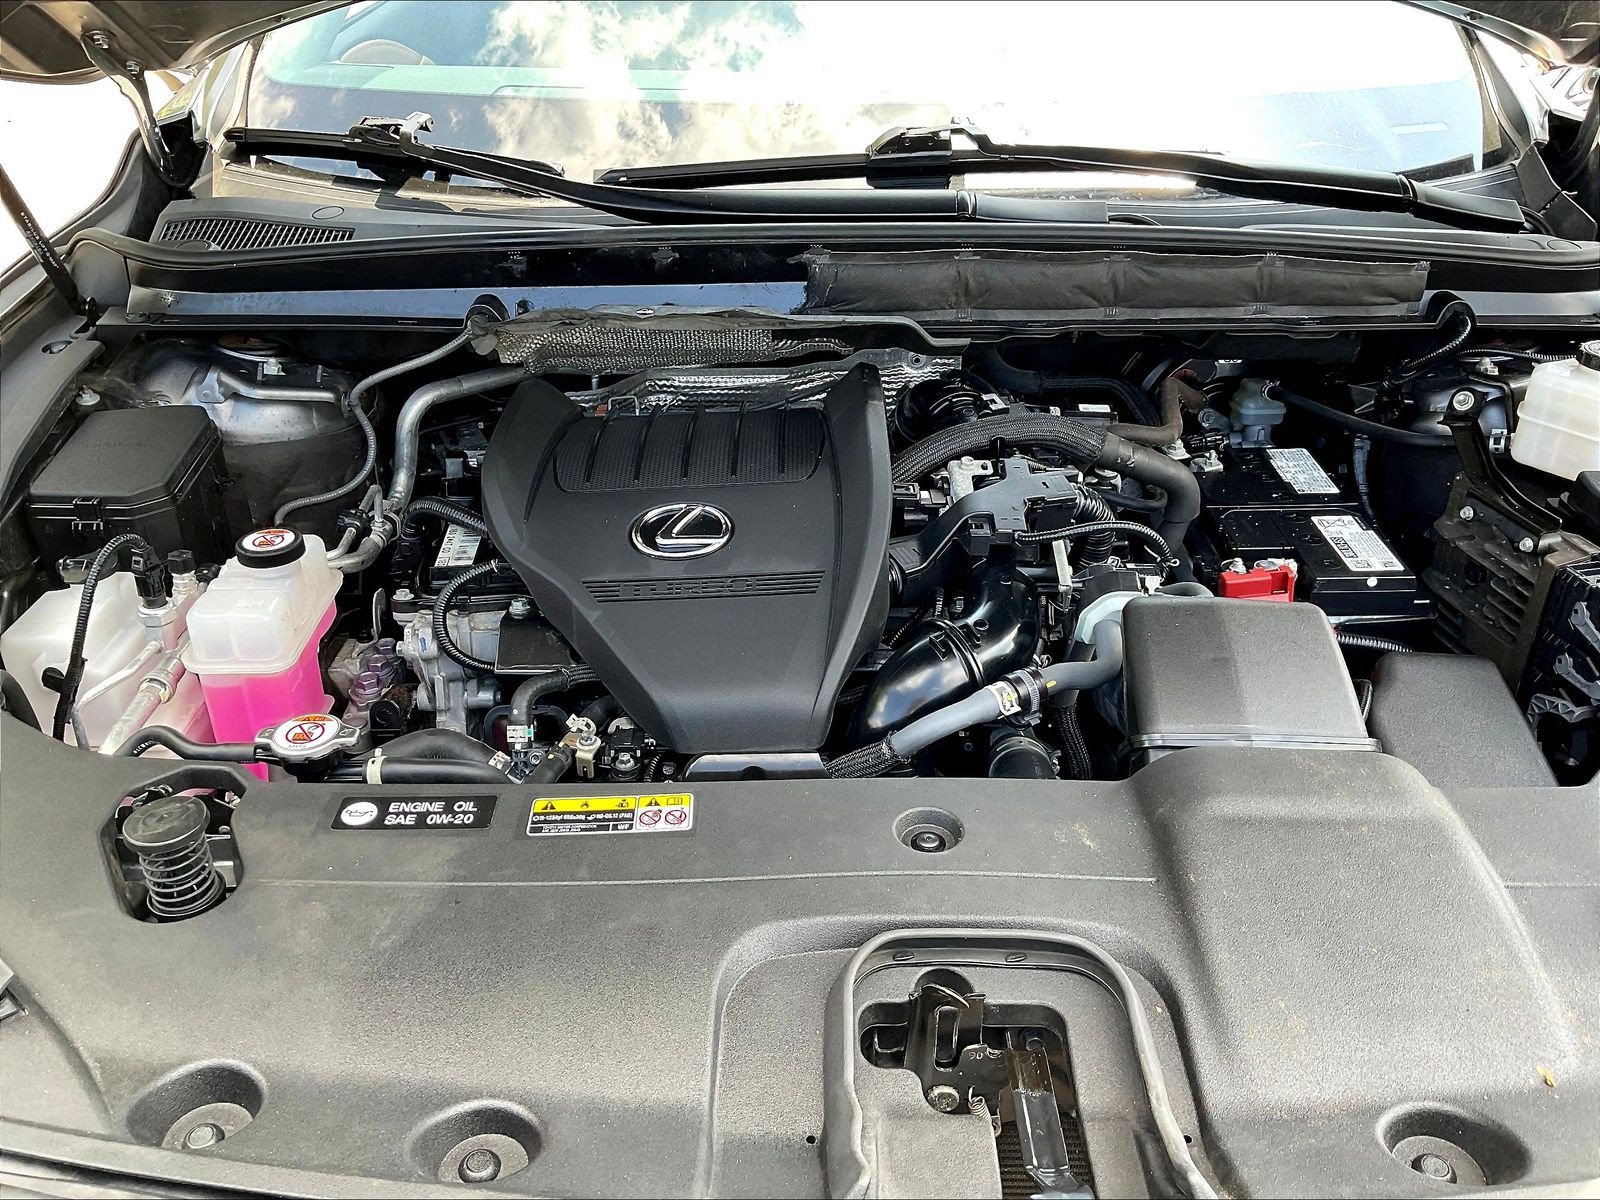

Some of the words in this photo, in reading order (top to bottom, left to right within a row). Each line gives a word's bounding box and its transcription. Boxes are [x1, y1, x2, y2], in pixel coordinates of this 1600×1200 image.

[388, 802, 445, 812] ENGINE
[453, 801, 478, 812] OIL
[384, 814, 417, 825] SAE
[426, 814, 474, 825] 0W-20
